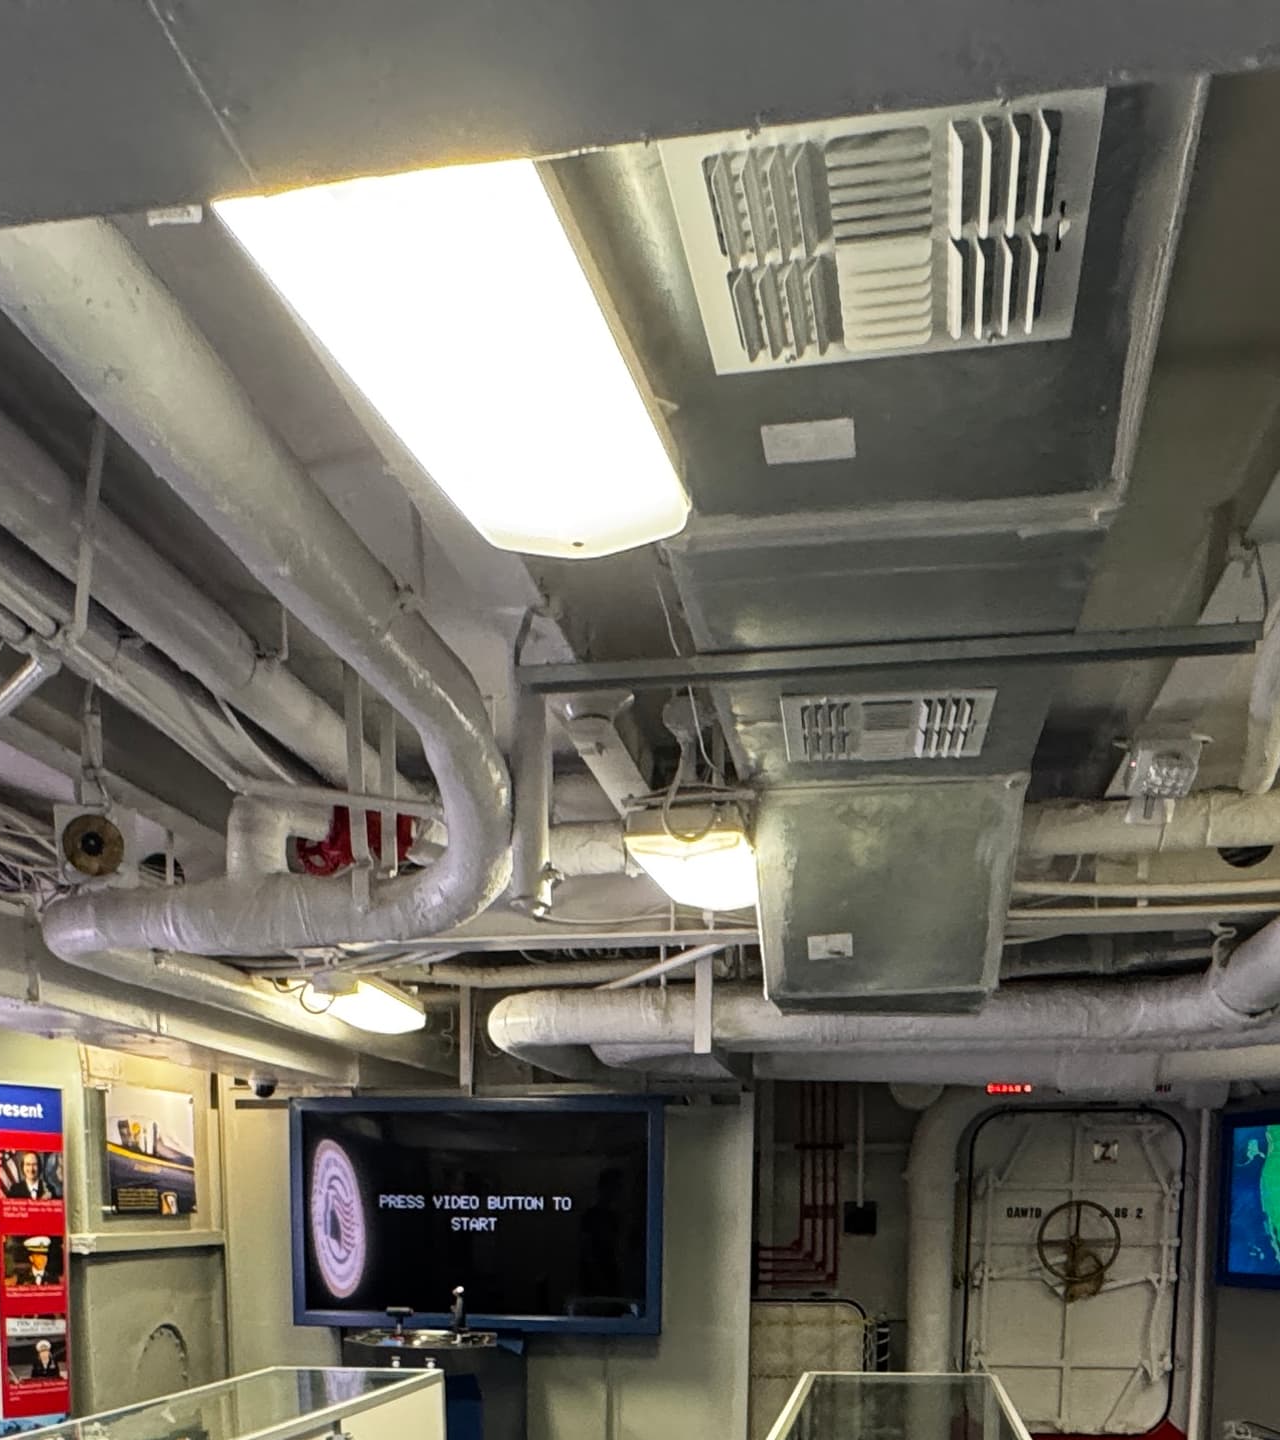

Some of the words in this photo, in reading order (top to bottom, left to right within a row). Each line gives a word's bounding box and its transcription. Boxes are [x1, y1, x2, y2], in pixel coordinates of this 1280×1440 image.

[378, 1194, 425, 1209] PRESS
[432, 1195, 480, 1210] VIDEO
[487, 1196, 544, 1210] BUTTON
[552, 1196, 572, 1211] TO
[450, 1216, 498, 1231] START
